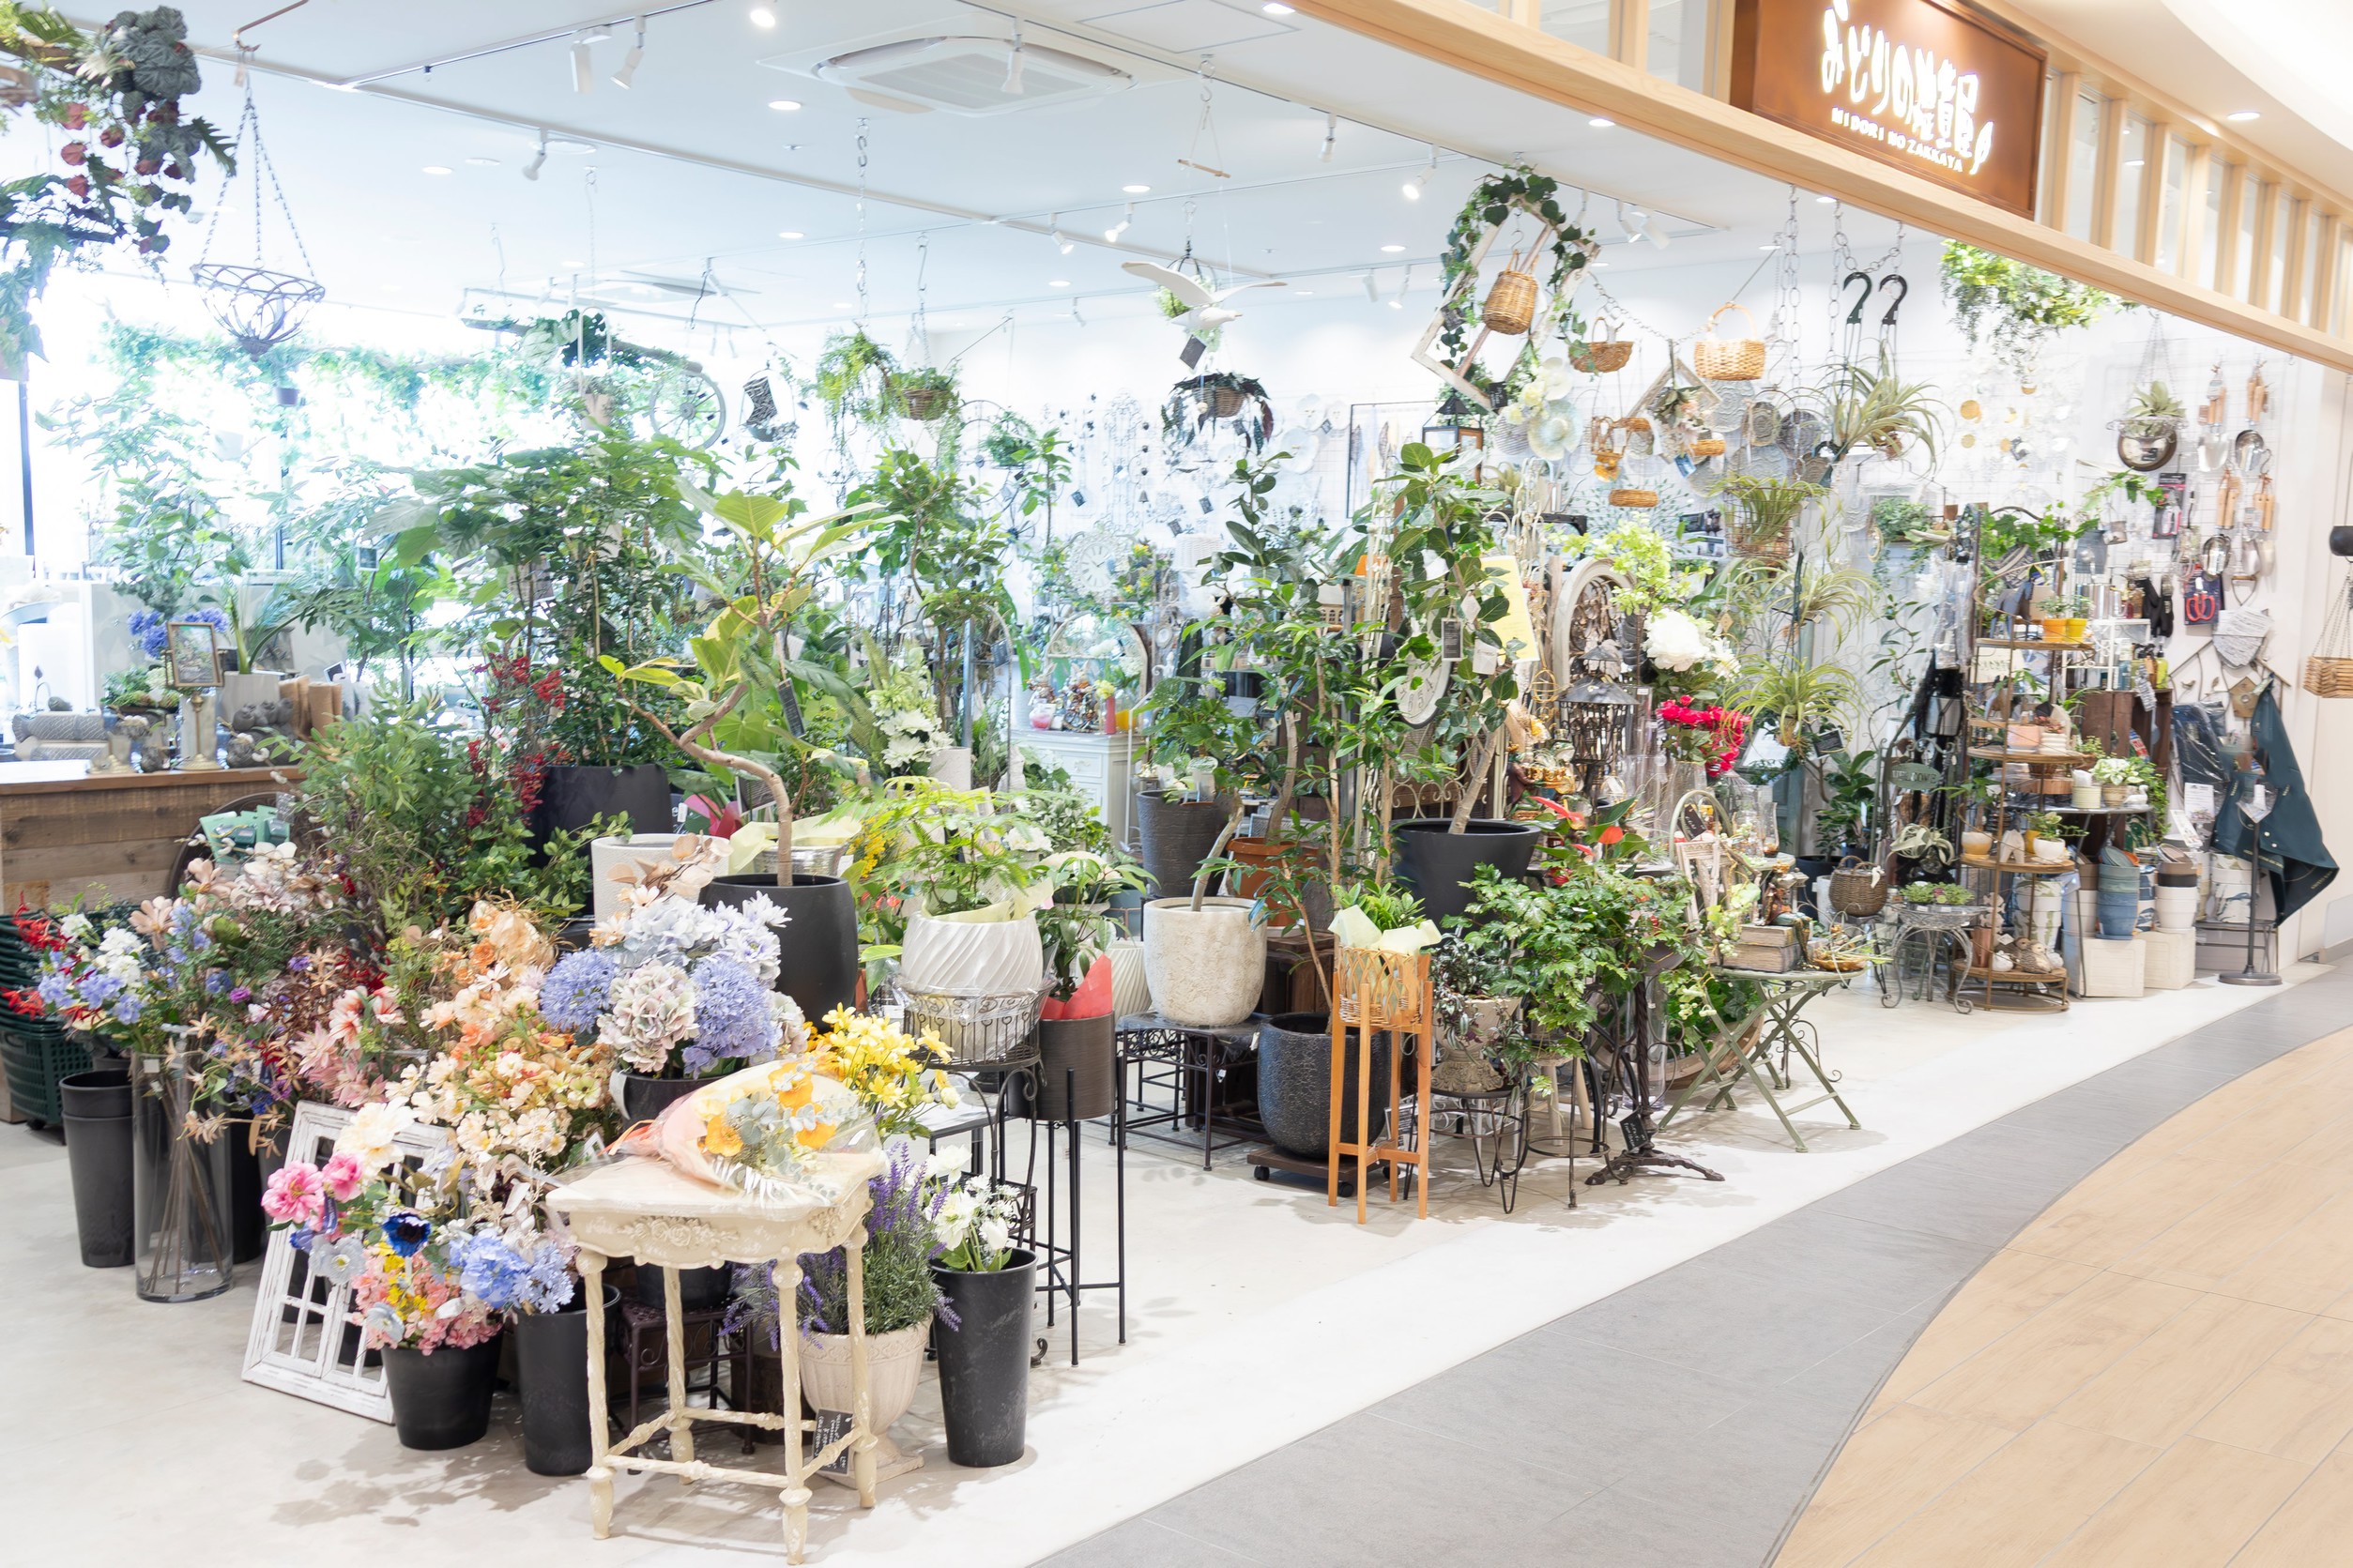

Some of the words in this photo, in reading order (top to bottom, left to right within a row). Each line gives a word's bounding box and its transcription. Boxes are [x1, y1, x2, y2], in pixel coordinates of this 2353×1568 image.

[1831, 106, 1885, 142] MIDORI
[1887, 129, 1906, 149] NO
[1907, 139, 1963, 173] ZAKKAYA
